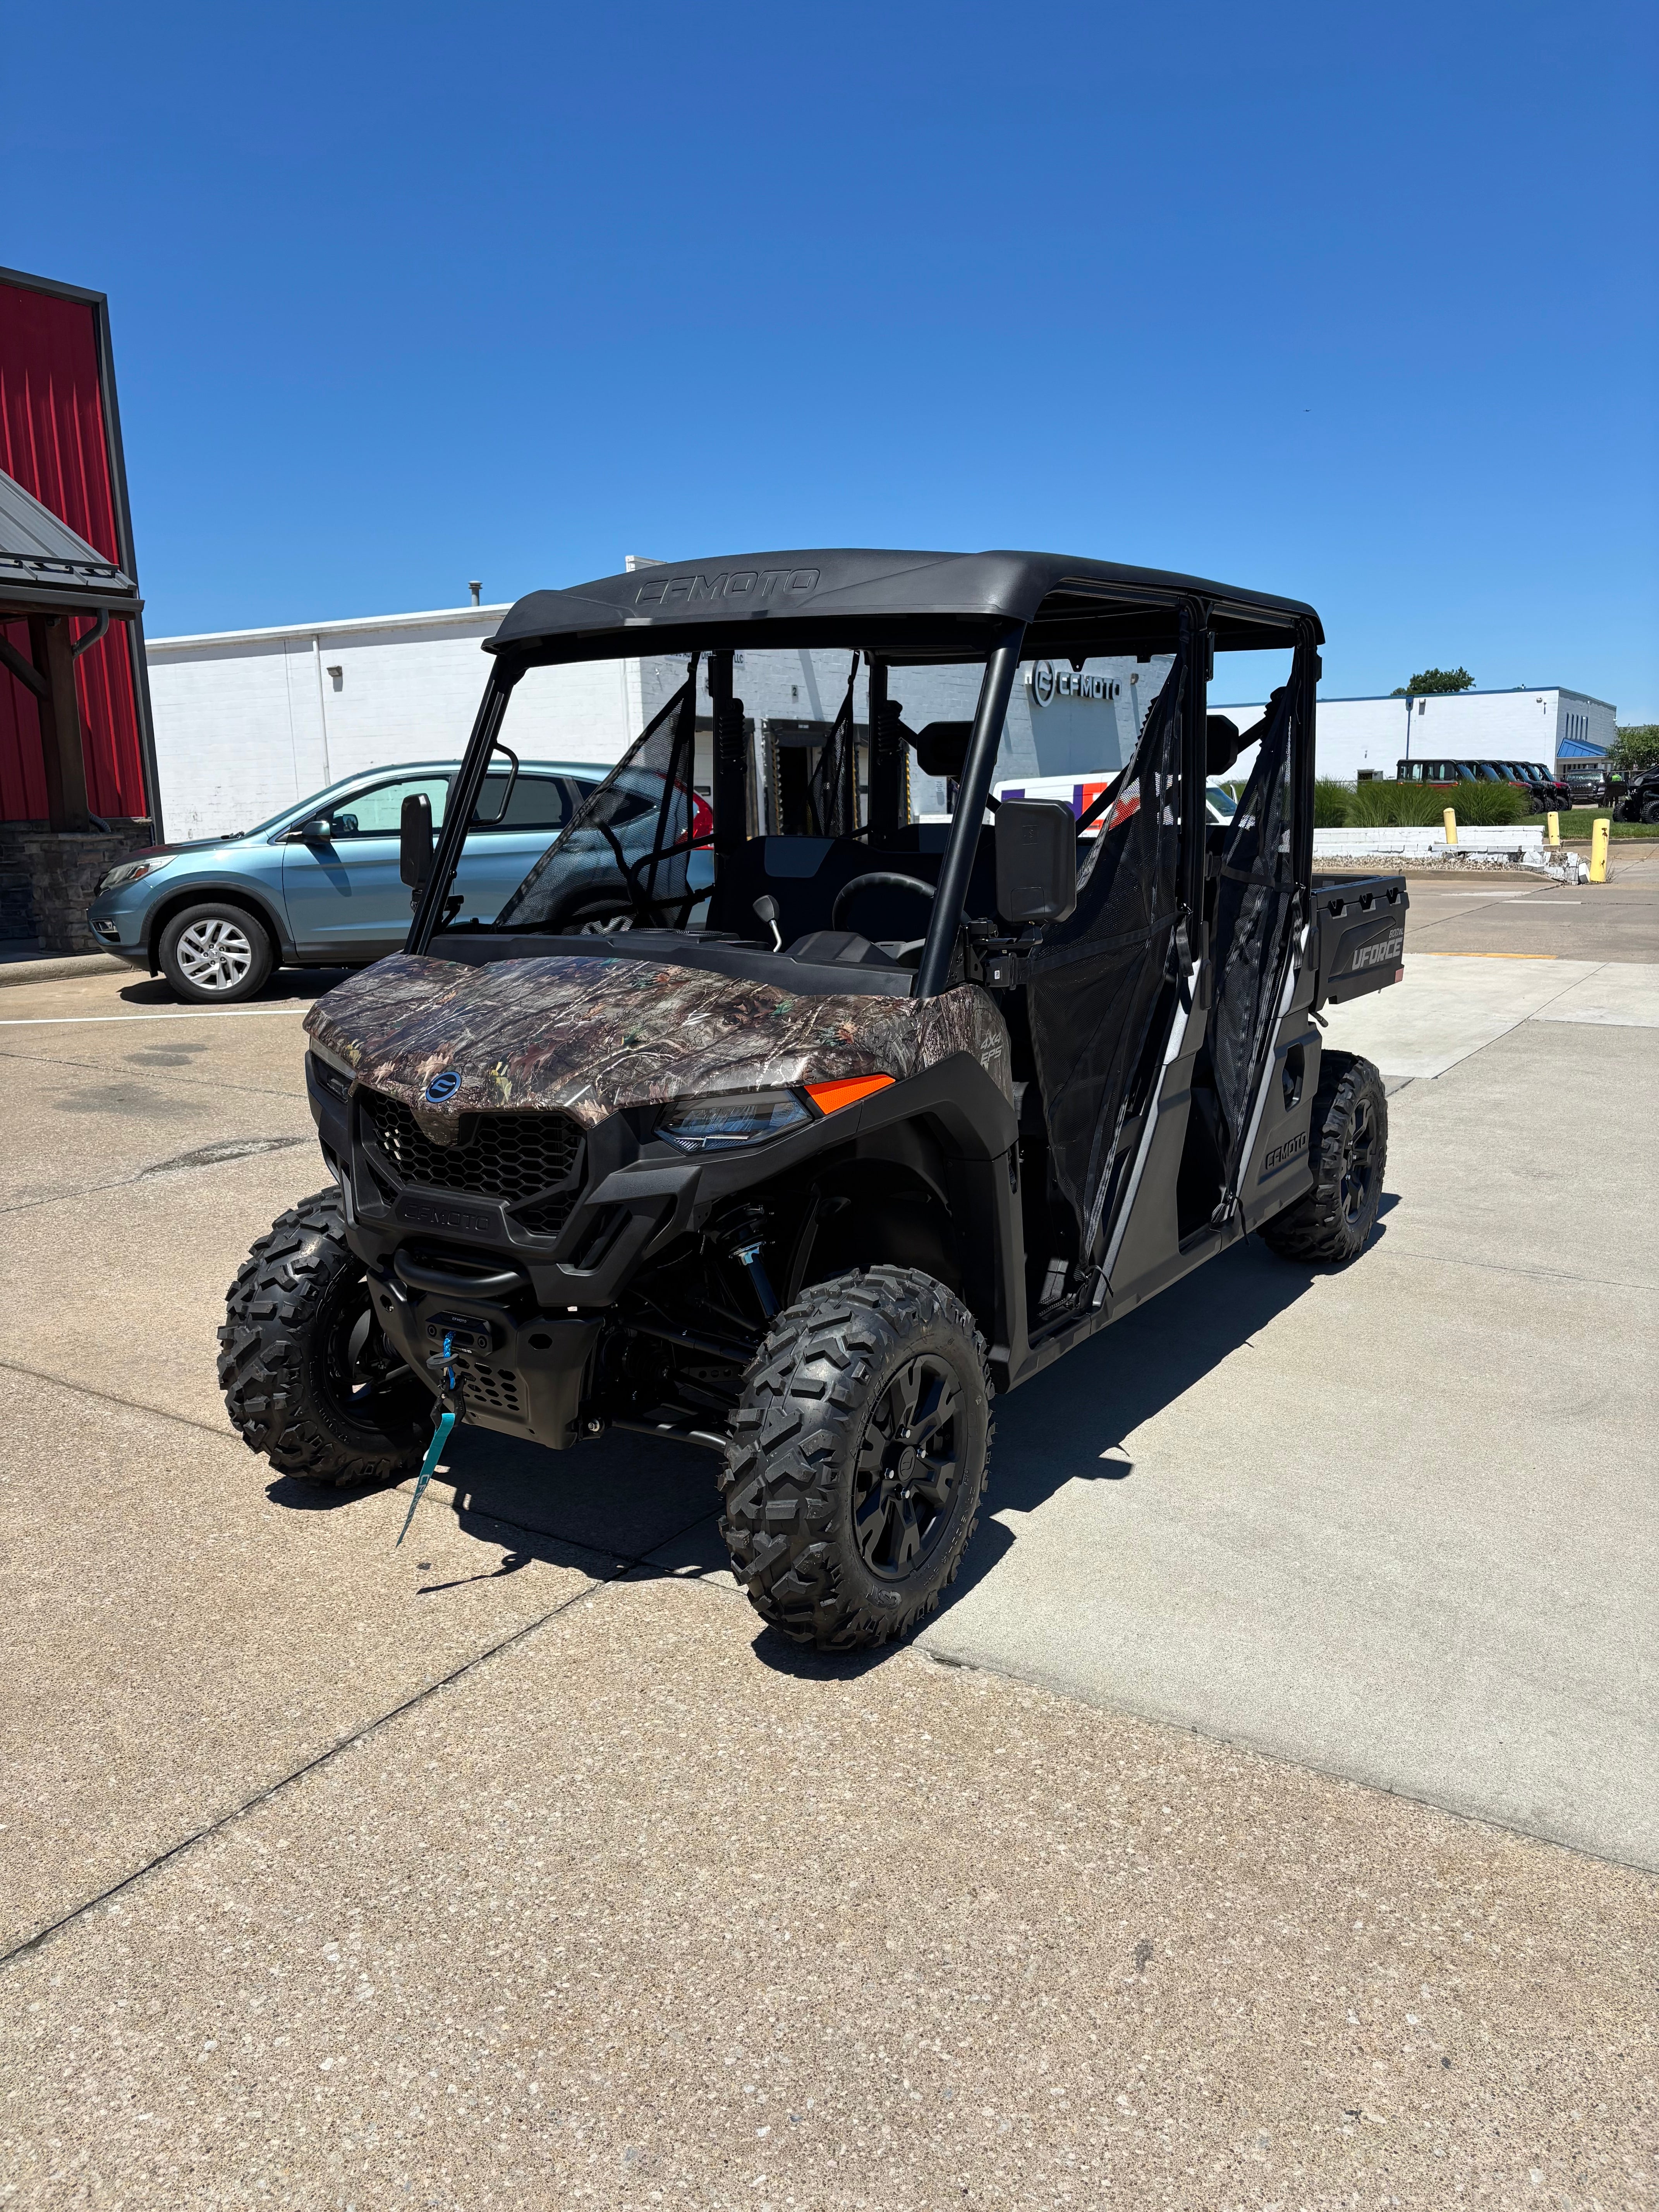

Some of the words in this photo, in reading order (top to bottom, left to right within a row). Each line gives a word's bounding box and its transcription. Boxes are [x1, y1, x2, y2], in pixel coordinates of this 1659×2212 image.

[635, 568, 821, 606] CFMOTO
[792, 687, 797, 696] 2
[1057, 672, 1122, 701] CFMOTO
[1352, 937, 1403, 970] UFORCE
[981, 1045, 1002, 1064] EPS
[1265, 1131, 1307, 1170] CFMOTO
[405, 1203, 489, 1232] CFMOTO
[865, 1583, 903, 1610] CST
